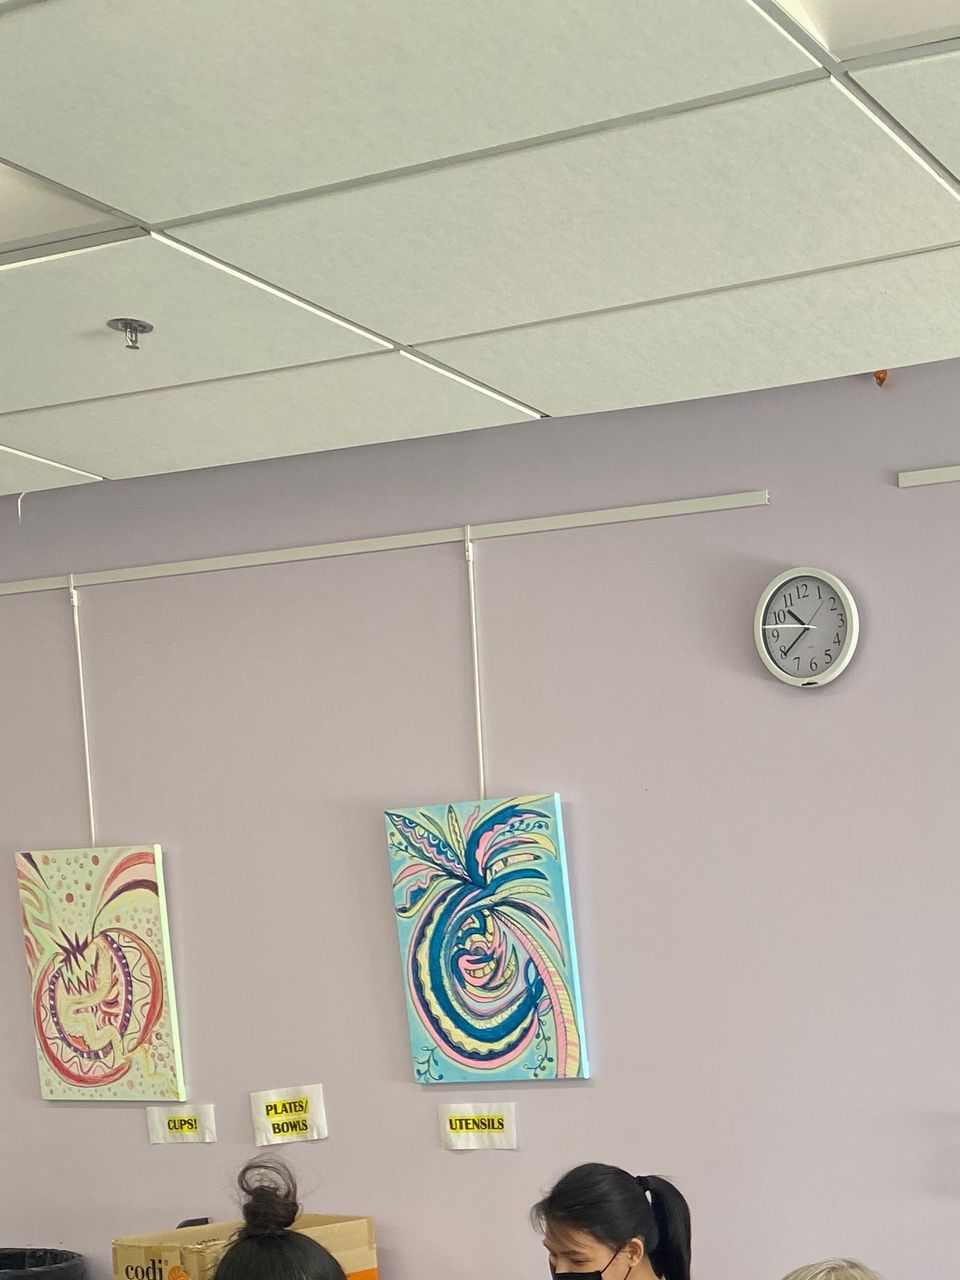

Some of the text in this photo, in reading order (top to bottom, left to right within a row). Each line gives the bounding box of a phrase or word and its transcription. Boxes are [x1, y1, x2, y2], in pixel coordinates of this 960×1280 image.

[796, 584, 809, 599] 12
[817, 586, 822, 599] 1
[783, 593, 793, 608] 11
[829, 597, 837, 611] 2
[773, 609, 786, 625] 10
[837, 614, 845, 628] 3
[771, 629, 780, 643] 9
[833, 633, 842, 646] 4
[779, 645, 788, 660] 8
[824, 649, 833, 664] 5
[793, 657, 801, 671] 7
[809, 657, 818, 671] 6
[265, 1100, 308, 1116] PLATES/
[167, 1118, 198, 1131] CUPS!
[272, 1119, 308, 1135] BOWLS
[448, 1117, 505, 1131] UTENSILS
